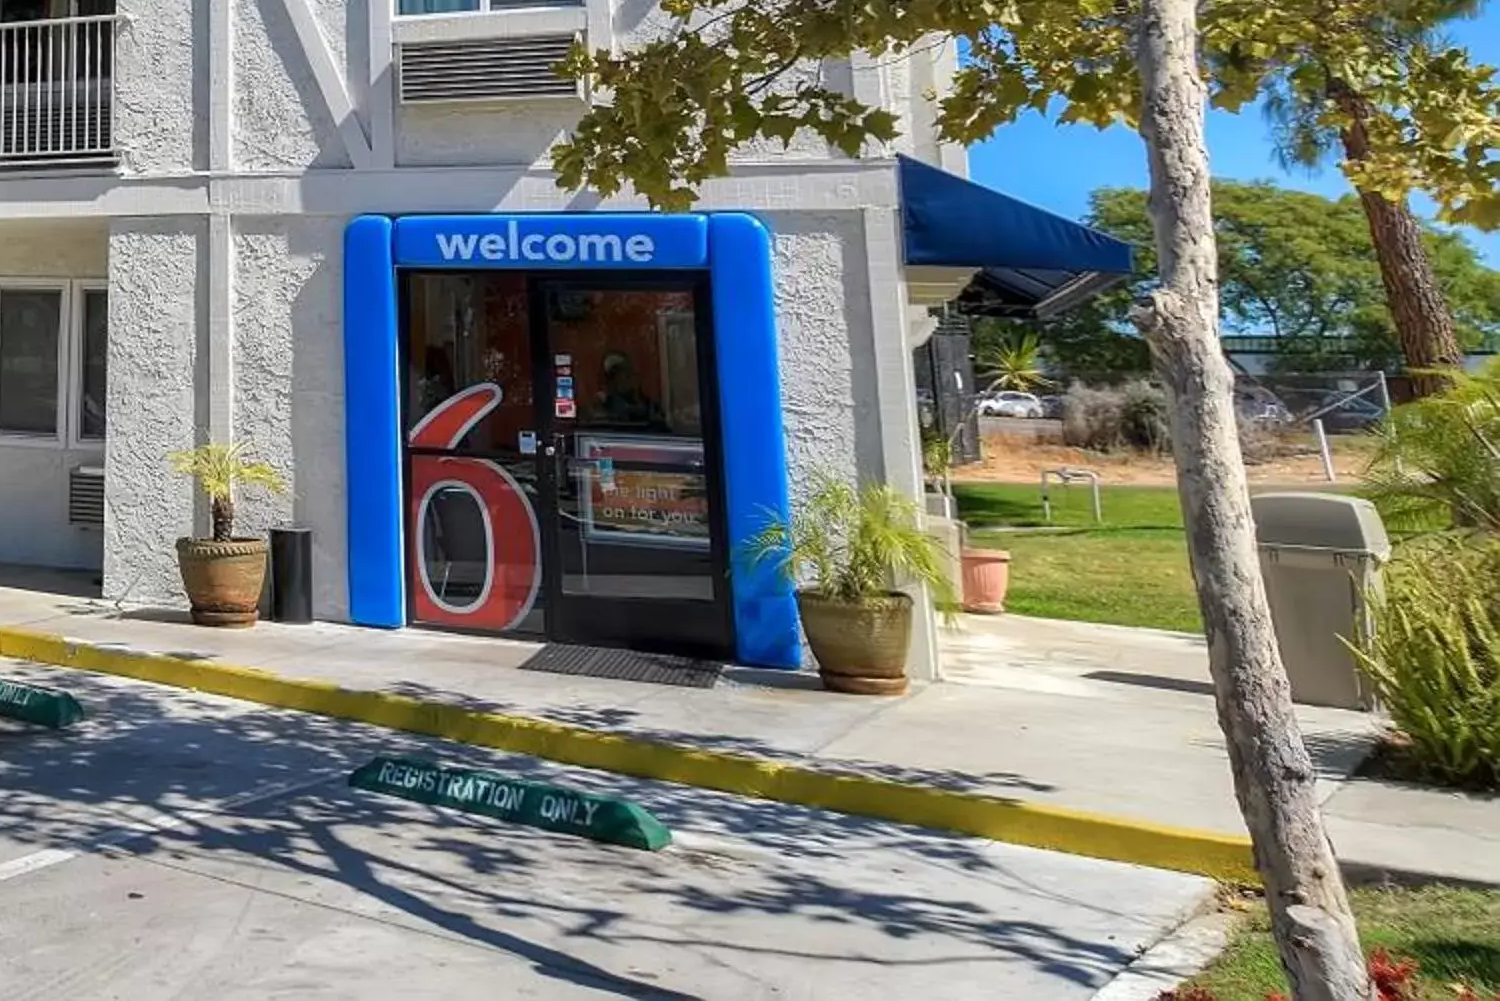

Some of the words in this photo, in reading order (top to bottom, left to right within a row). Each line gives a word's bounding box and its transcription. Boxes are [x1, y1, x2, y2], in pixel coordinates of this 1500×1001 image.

[435, 220, 655, 262] welcome
[636, 485, 675, 501] light
[602, 507, 625, 519] on
[630, 504, 657, 520] for
[378, 762, 525, 812] REGISTRATION
[540, 795, 600, 826] ONLY
